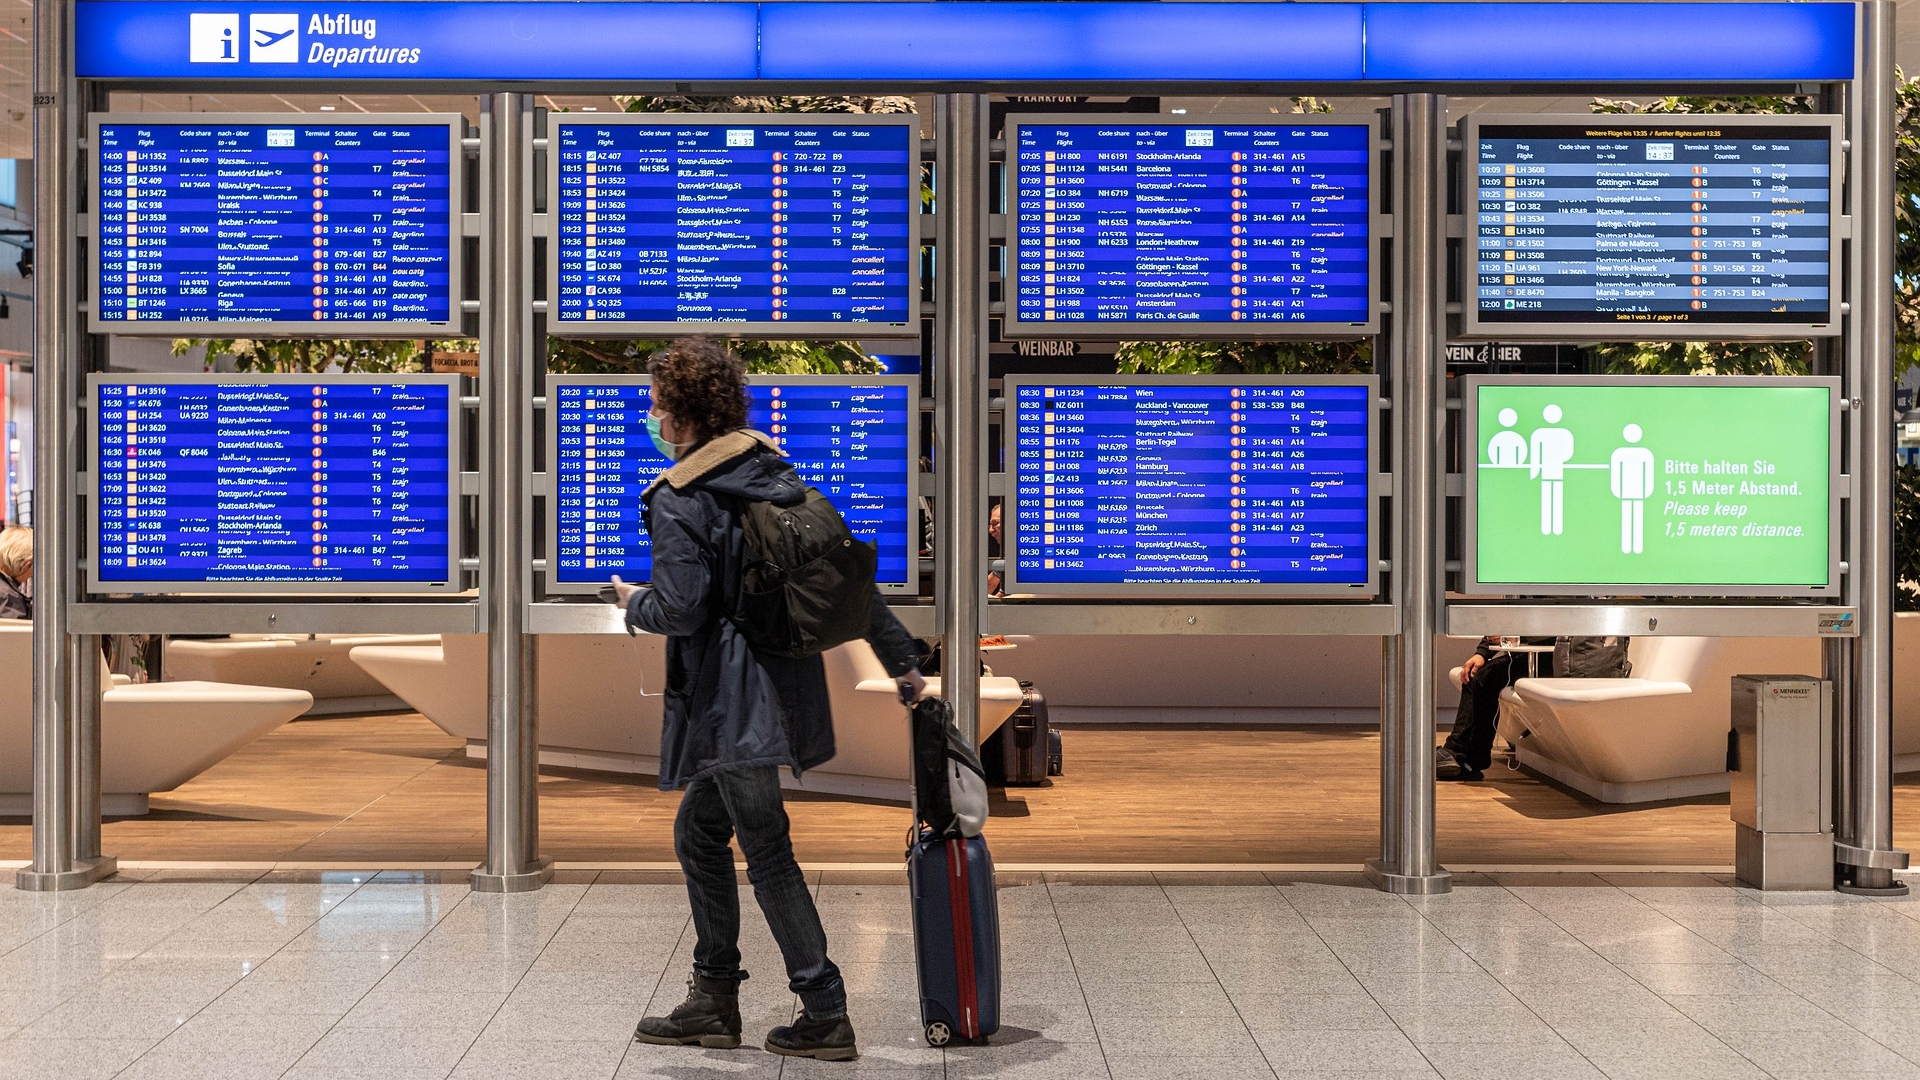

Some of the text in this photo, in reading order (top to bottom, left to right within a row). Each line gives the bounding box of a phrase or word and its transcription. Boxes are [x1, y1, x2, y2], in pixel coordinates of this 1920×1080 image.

[307, 14, 376, 38] Abflug
[306, 42, 421, 66] Departures
[1596, 179, 1631, 187] Göttingen
[1136, 263, 1171, 272] Göttingen
[1625, 289, 1655, 298] Bangkok
[218, 299, 233, 308] Riga
[1019, 341, 1074, 356] WEINBAR
[1136, 439, 1176, 447] Berlin-Tegel
[1136, 463, 1168, 471] Hamburg
[1665, 459, 1775, 474] Bitte halten Sie
[1665, 480, 1802, 497] 1,5 Meter Abstand.
[1664, 501, 1747, 518] Please keep
[1665, 522, 1804, 538] 1,5 meters distance.
[218, 546, 242, 555] Zagreb
